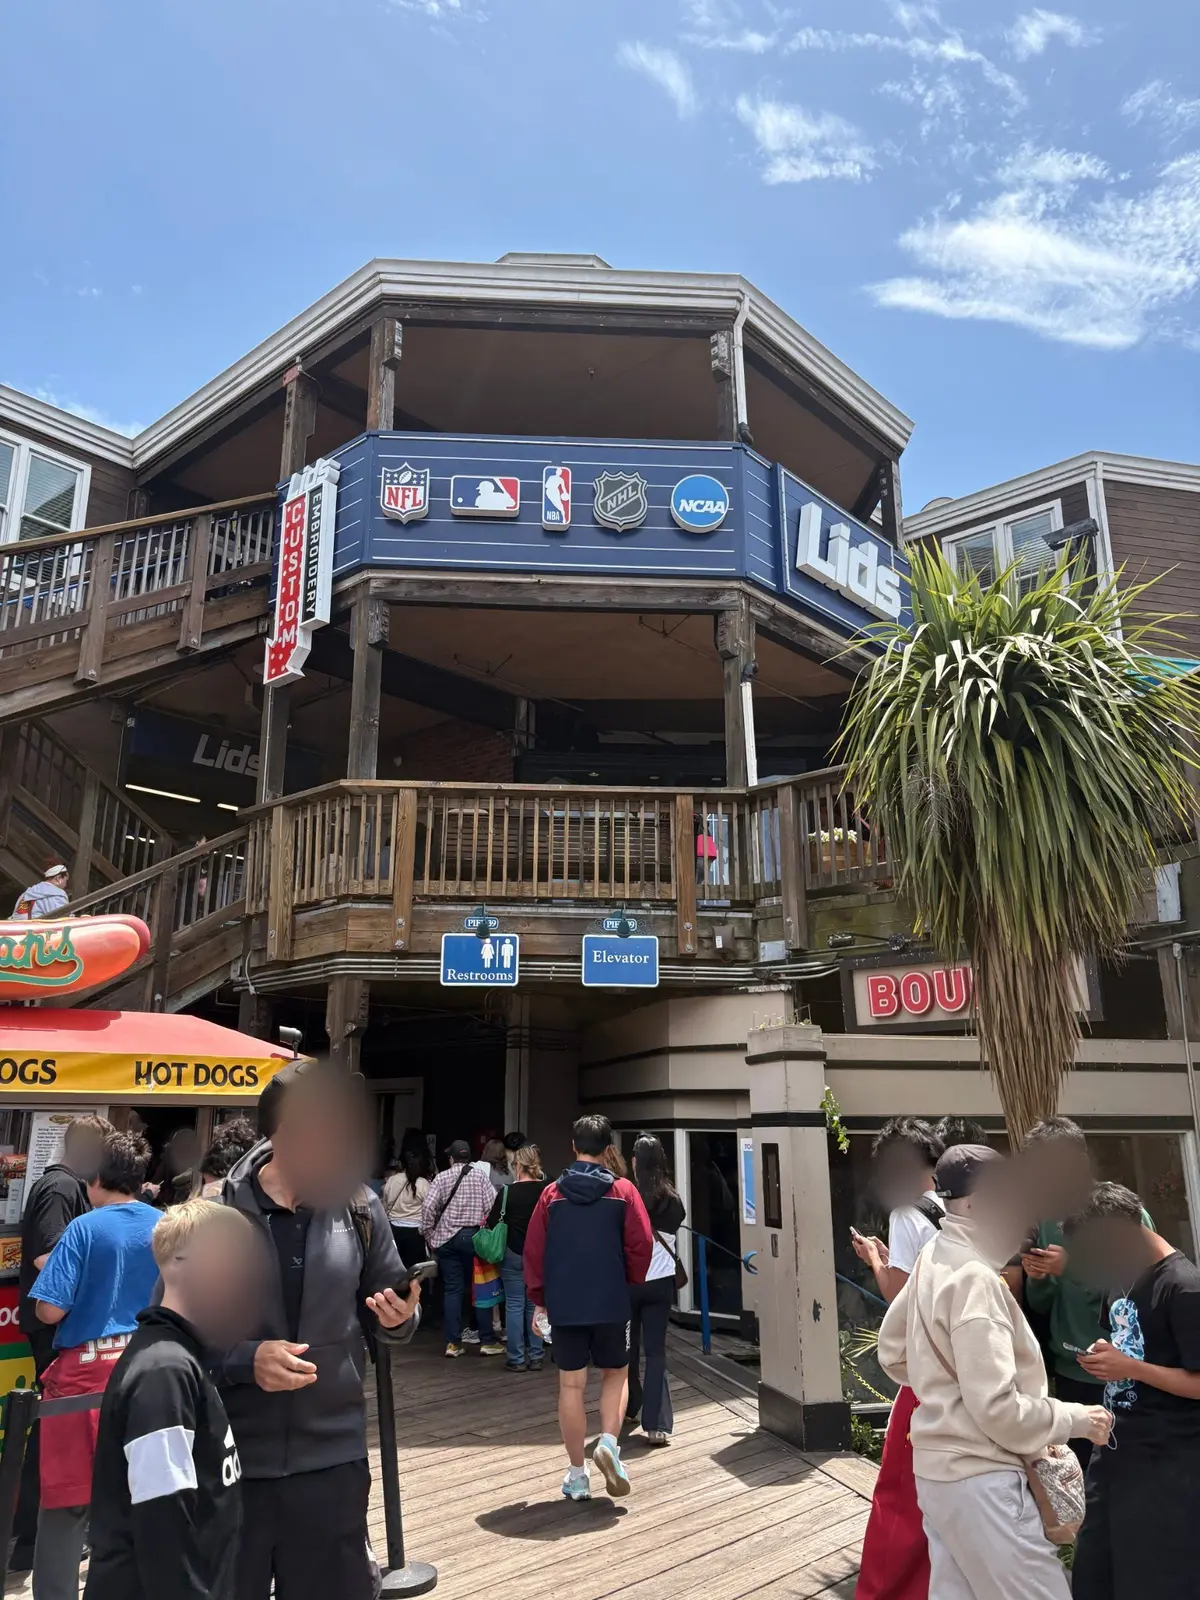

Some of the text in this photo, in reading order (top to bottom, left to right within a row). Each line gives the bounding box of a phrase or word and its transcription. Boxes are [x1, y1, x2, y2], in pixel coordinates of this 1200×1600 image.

[386, 486, 423, 510] NFL
[606, 485, 637, 512] NHL
[678, 498, 726, 514] NCAA
[546, 510, 560, 521] NBA
[305, 491, 322, 615] EMBROIDERY
[796, 501, 902, 620] Lids
[282, 502, 302, 649] CUSTOM
[592, 949, 650, 965] Elevator
[446, 968, 514, 982] Restrooms
[867, 966, 972, 1019] BOU
[135, 1060, 260, 1088] HOT DOGS
